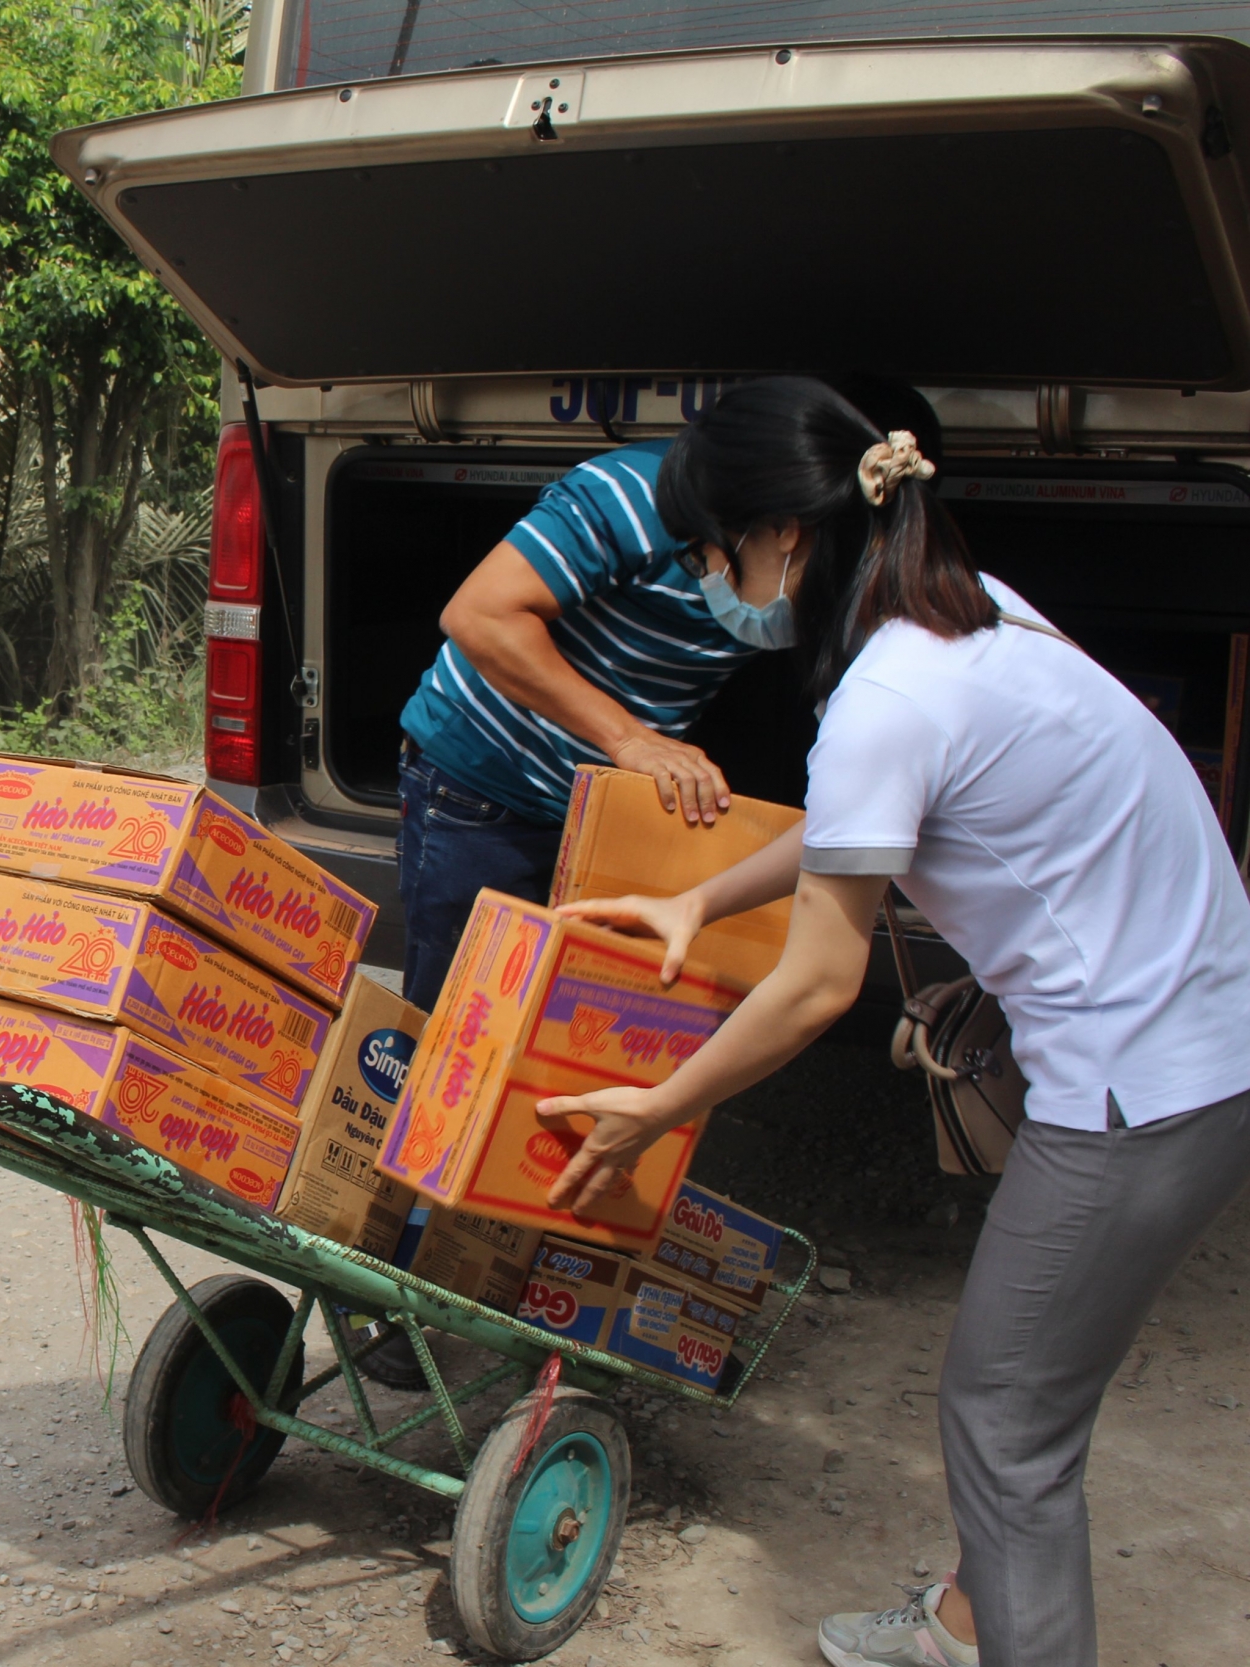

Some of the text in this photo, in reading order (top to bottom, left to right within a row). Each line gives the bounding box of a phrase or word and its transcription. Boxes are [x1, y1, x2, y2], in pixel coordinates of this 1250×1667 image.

[469, 470, 508, 482] HYUNDAI
[509, 471, 555, 483] ALUMINUM
[985, 483, 1126, 499] HYUNDAI ALUMINUM VINA
[113, 786, 131, 796] CÔNG
[22, 797, 118, 831] Hảo Hảo
[107, 816, 167, 860] 20
[62, 900, 80, 911] CÔNG
[225, 867, 274, 919] Hảo
[274, 888, 321, 939] Hảo
[18, 910, 67, 945] Hảo
[57, 932, 115, 977] 20
[309, 940, 346, 983] 20
[177, 982, 275, 1049] Hảo Hảo
[364, 1036, 409, 1089] Simp
[619, 1024, 667, 1066] Hảo
[260, 1050, 301, 1094] 20
[119, 1074, 169, 1124] 20
[331, 1085, 387, 1130] Dầu Đậu
[158, 1113, 200, 1152] Hảo
[199, 1124, 240, 1163] Hảo
[345, 1121, 376, 1147] Nguyên
